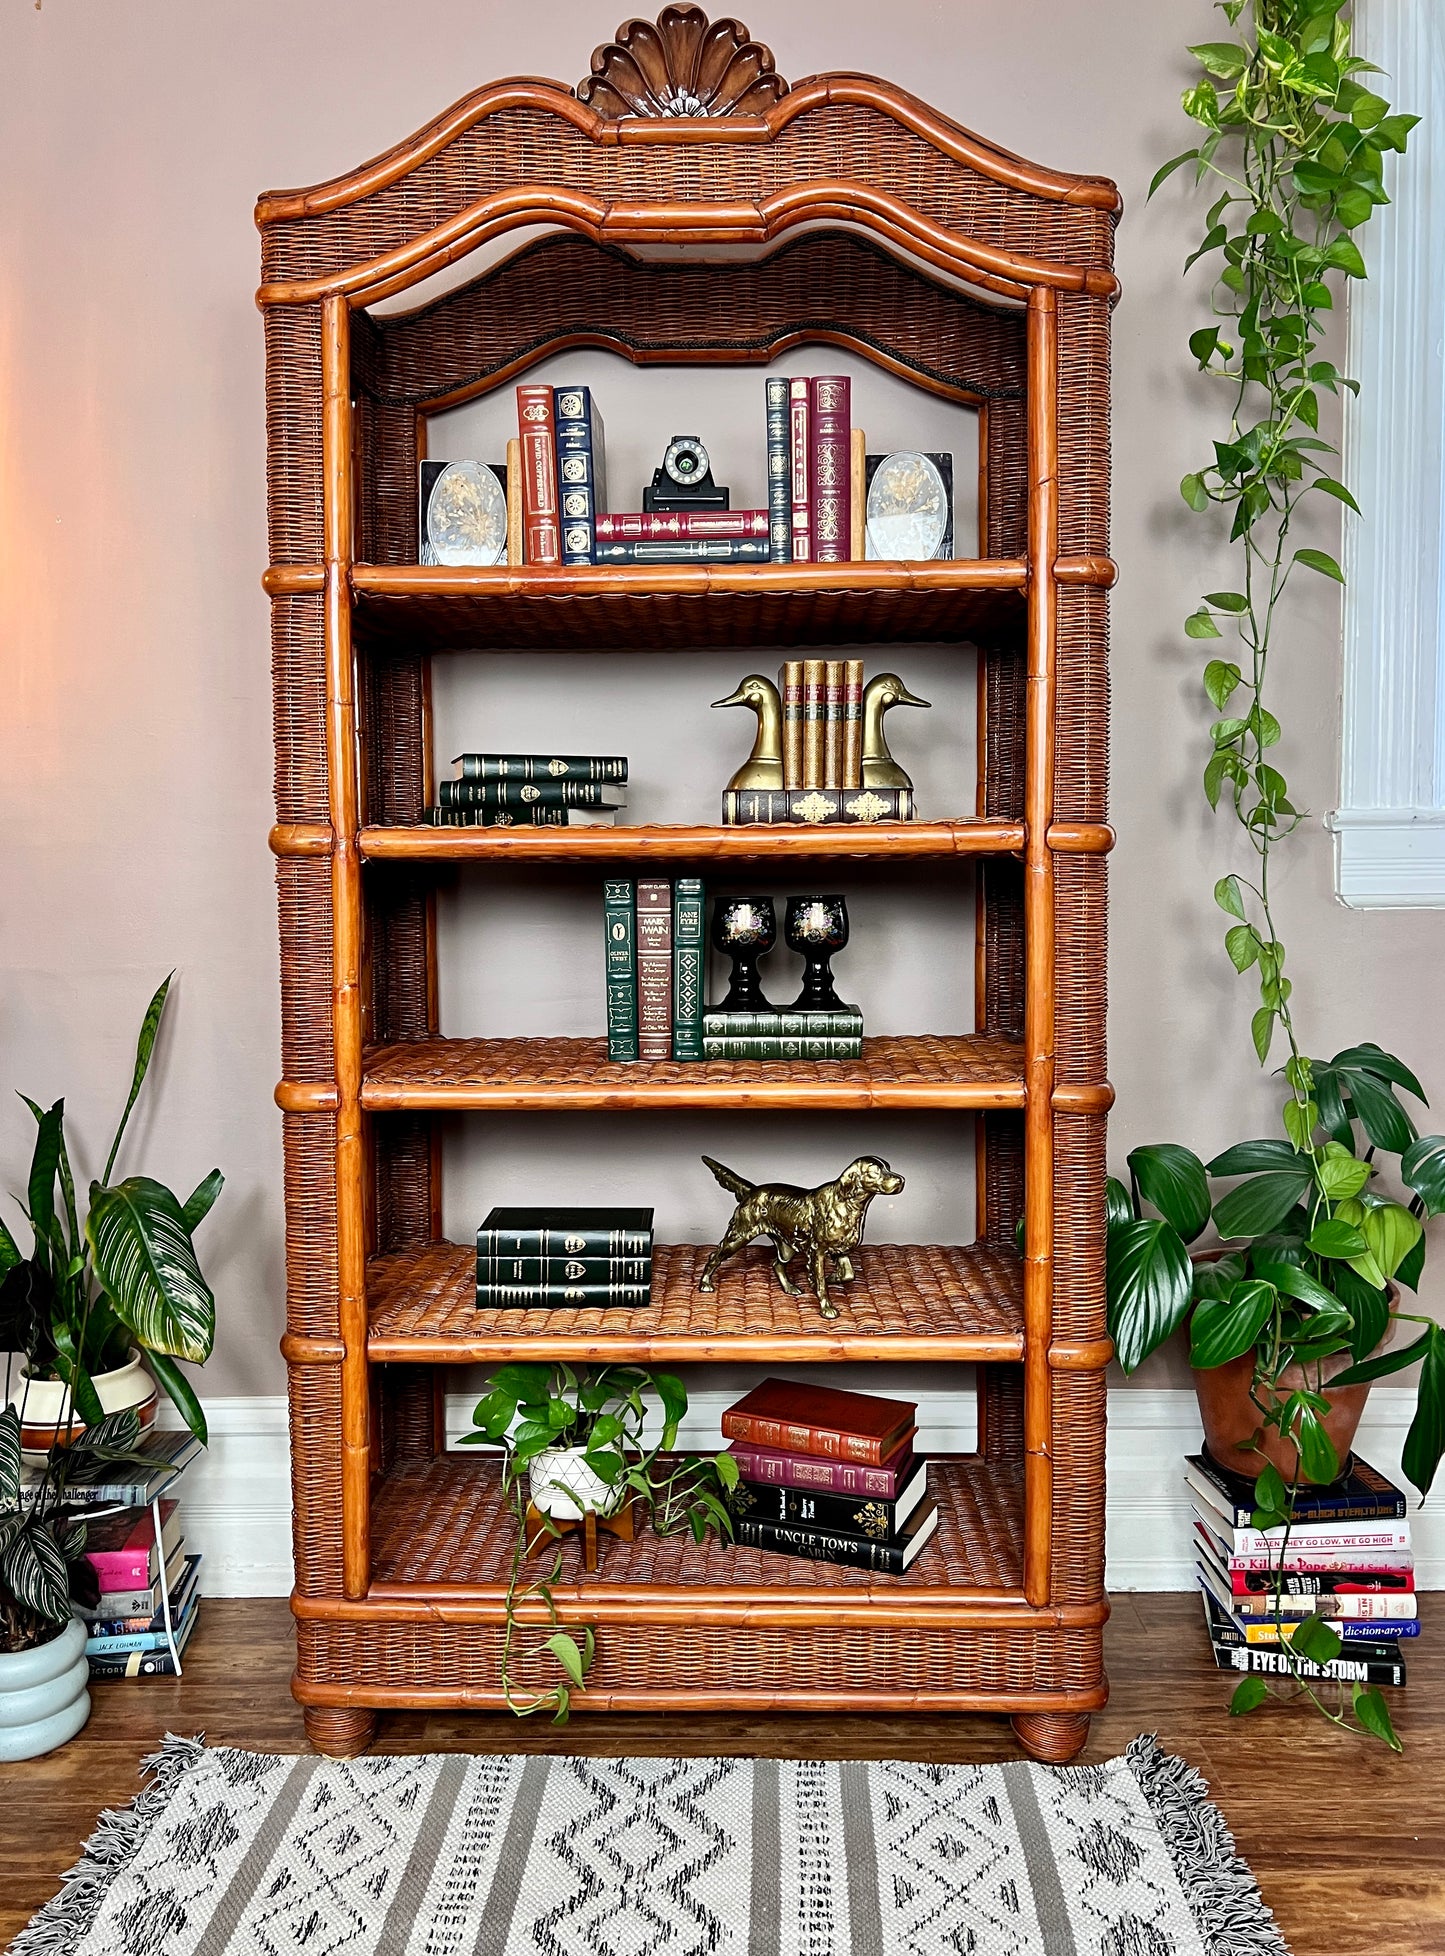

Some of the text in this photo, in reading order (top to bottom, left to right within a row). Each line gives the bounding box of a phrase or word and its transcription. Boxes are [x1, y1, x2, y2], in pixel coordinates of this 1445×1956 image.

[534, 438, 545, 508] DAVID COPPERFIELD
[643, 917, 666, 926] MARK
[679, 911, 698, 919] JANE
[640, 926, 669, 935] TWAIN
[61, 1487, 99, 1503] hallenger
[774, 1528, 816, 1546] UNCLE
[820, 1536, 858, 1554] TOM'S
[1372, 1536, 1393, 1544] HIGH
[1230, 1558, 1245, 1569] To
[1249, 1558, 1270, 1569] Kil
[1297, 1557, 1327, 1572] Pope
[1258, 1630, 1294, 1641] Stuen
[1252, 1650, 1277, 1673] EYE
[1294, 1655, 1321, 1678] THE
[1321, 1658, 1369, 1682] STORM
